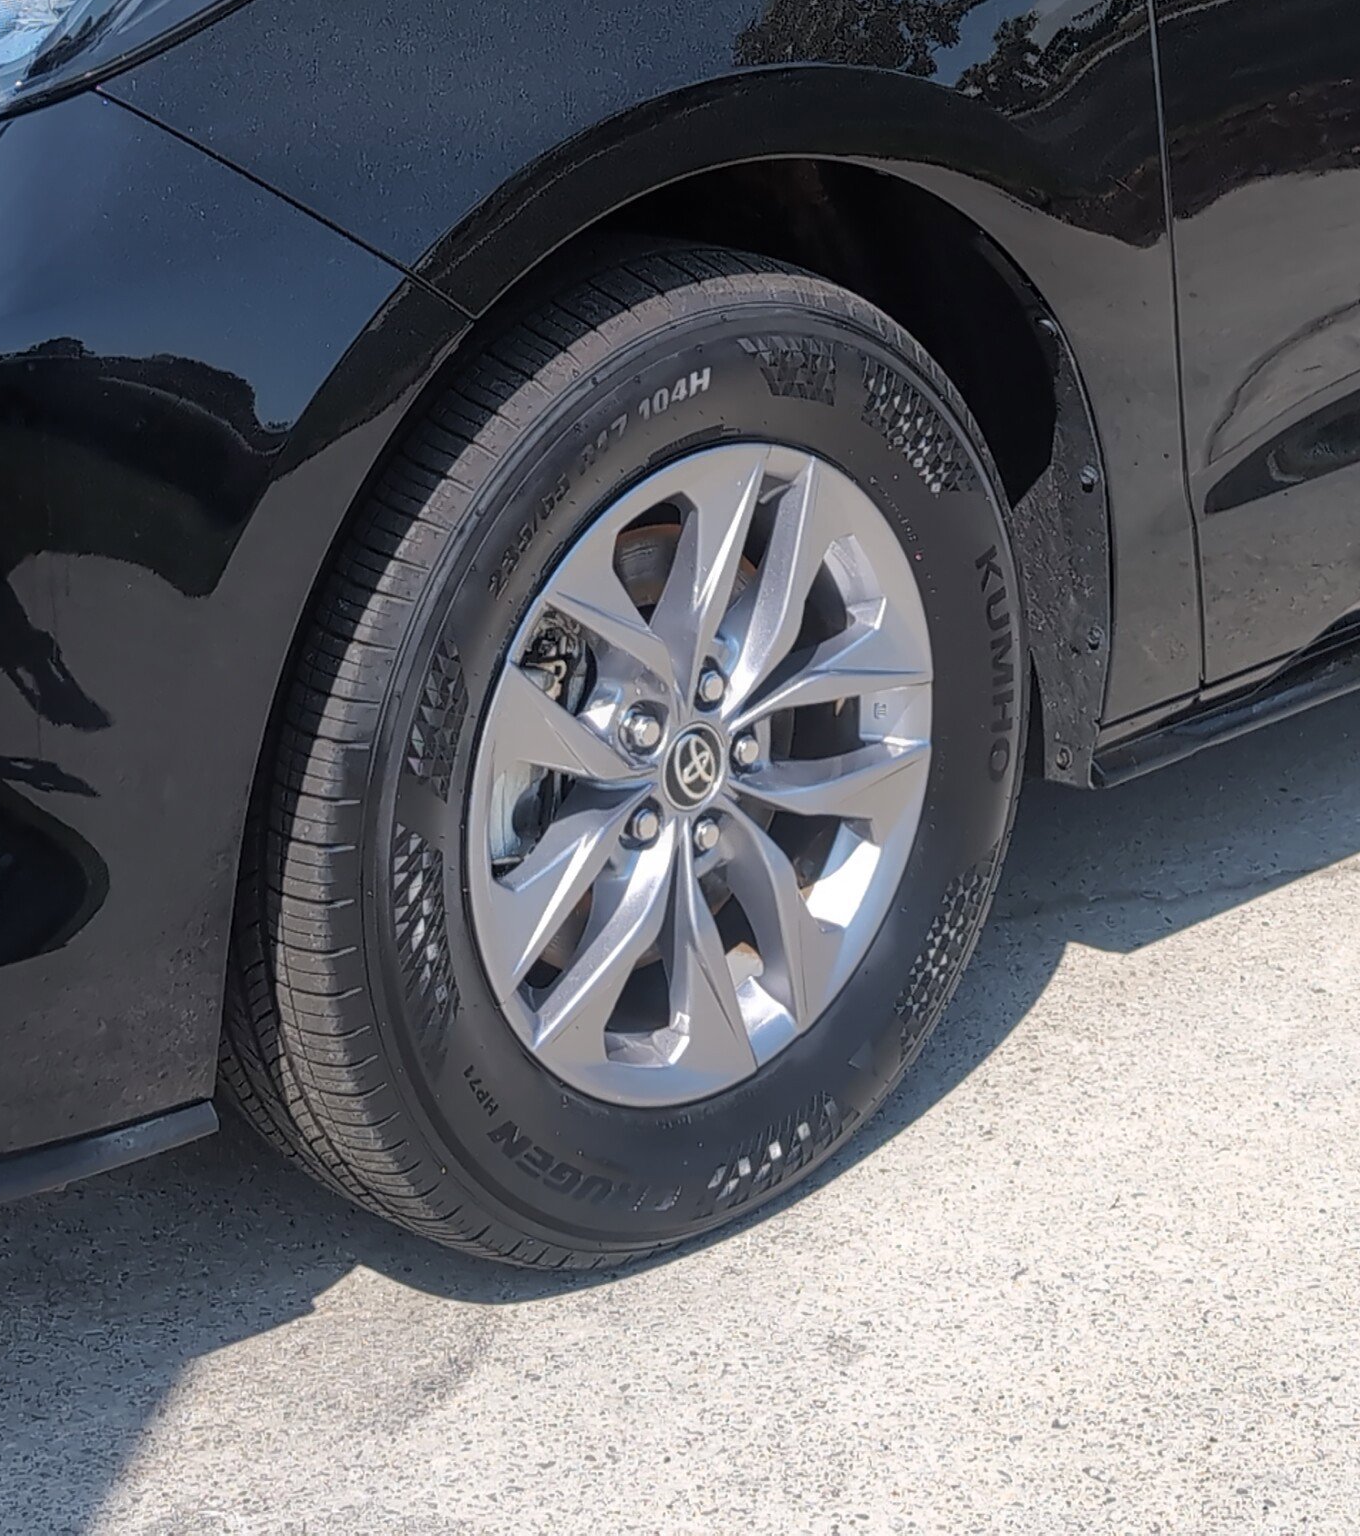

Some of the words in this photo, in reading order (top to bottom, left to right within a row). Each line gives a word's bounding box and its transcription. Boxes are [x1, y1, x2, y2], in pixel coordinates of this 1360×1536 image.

[636, 366, 712, 421] 104H
[974, 543, 1015, 783] KUMHO
[462, 1064, 500, 1118] HP71
